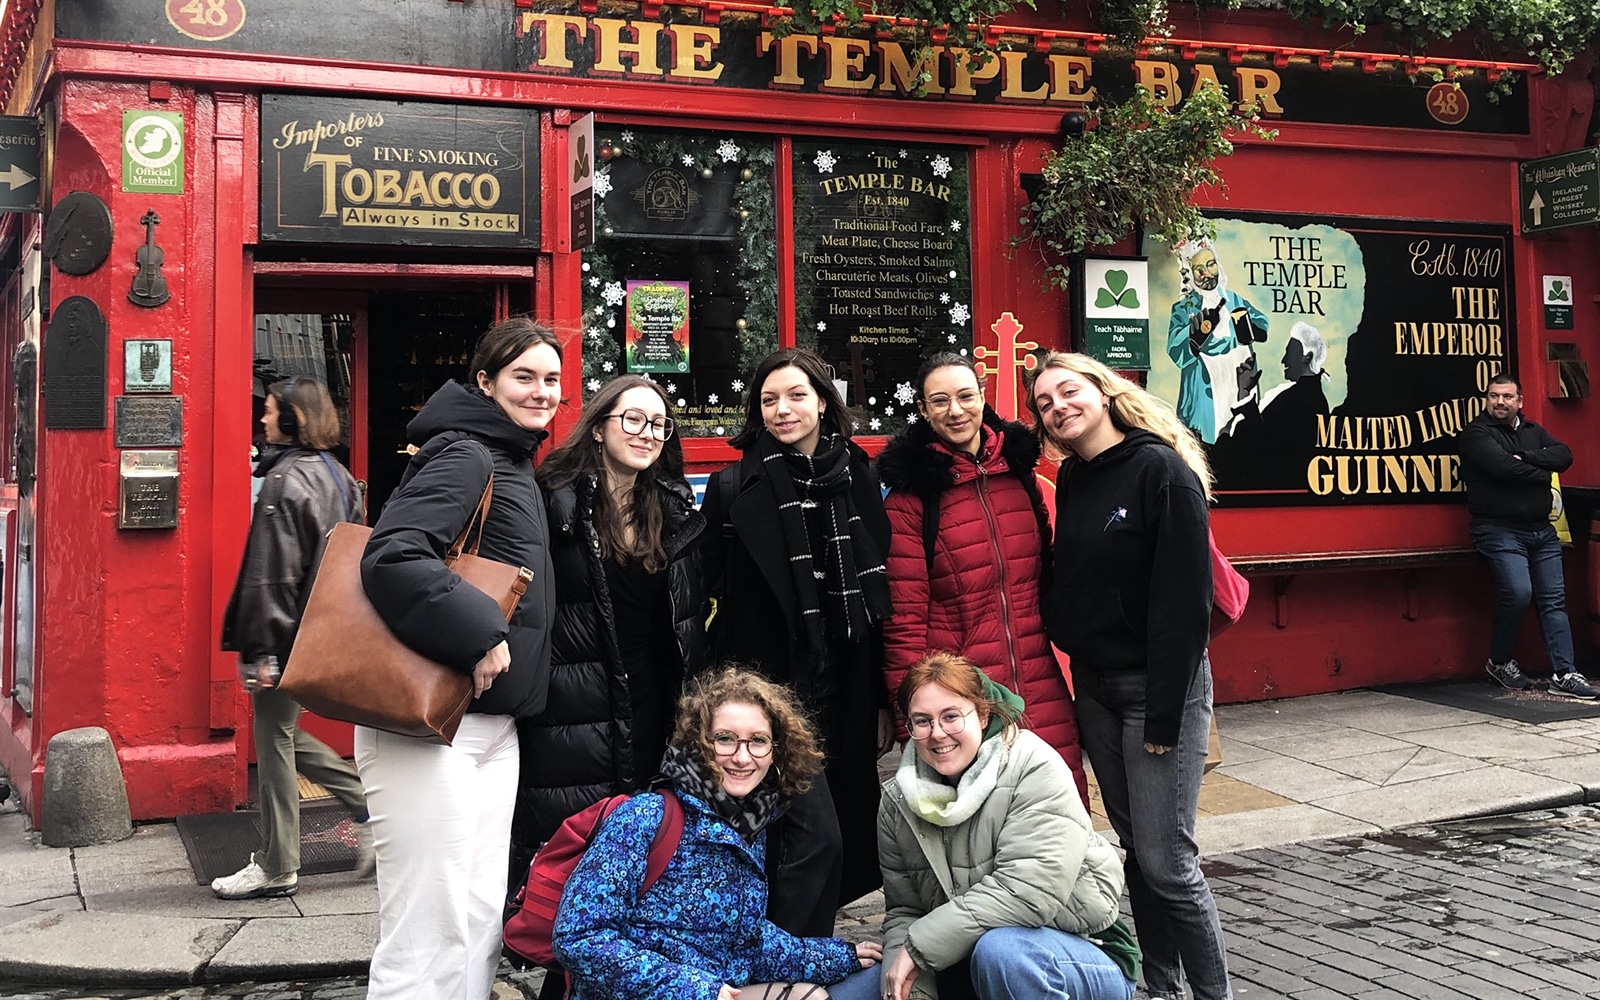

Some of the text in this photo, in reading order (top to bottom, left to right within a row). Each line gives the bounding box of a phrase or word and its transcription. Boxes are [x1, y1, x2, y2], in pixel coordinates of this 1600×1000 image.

[180, 0, 228, 26] 48
[518, 12, 1285, 114] THE TEMPLE BAR
[1432, 89, 1460, 115] 48
[272, 111, 385, 152] Importers
[0, 133, 37, 146] eserve
[343, 136, 363, 147] OF
[373, 146, 501, 168] FINE SMOKING
[875, 156, 898, 169] The
[136, 167, 171, 176] Official
[653, 170, 680, 180] TEMPLE
[133, 176, 174, 185] Member
[303, 151, 502, 218] TOBACCO
[820, 173, 951, 202] TEMPLE BAR
[1552, 185, 1588, 196] IRELAND'S
[865, 194, 909, 206] Est. 1840
[1552, 194, 1583, 204] LARGEST
[1553, 201, 1585, 211] WHISKEY
[345, 208, 517, 230] Always in Stock
[1553, 207, 1597, 219] COLLECTION
[833, 218, 888, 231] Traditional
[892, 221, 918, 232] Food
[822, 235, 953, 250] Meat Plate, Cheese Board
[1269, 236, 1323, 262] THE
[802, 252, 831, 264] Fresh
[834, 253, 876, 268] Oysters,
[879, 255, 920, 267] Smoked
[1462, 247, 1502, 278] 1840
[879, 271, 913, 283] Meats,
[915, 272, 948, 284] Olives
[1243, 261, 1348, 289] TEMPLE
[831, 286, 935, 300] Toasted Sandwiches
[829, 304, 937, 316] Hot Roast Beef Rolls
[1271, 289, 1326, 317] BAR
[1451, 286, 1500, 320] THE
[648, 314, 670, 323] Temple
[671, 314, 683, 322] Bar
[859, 326, 887, 334] Kitchen
[1393, 321, 1504, 358] EMPEROR
[1476, 360, 1503, 393] OF
[688, 405, 702, 414] and
[704, 405, 722, 414] loved
[724, 405, 738, 414] and
[1315, 413, 1412, 451] MALTED
[1307, 455, 1468, 496] GUINNE
[140, 484, 160, 492] THE
